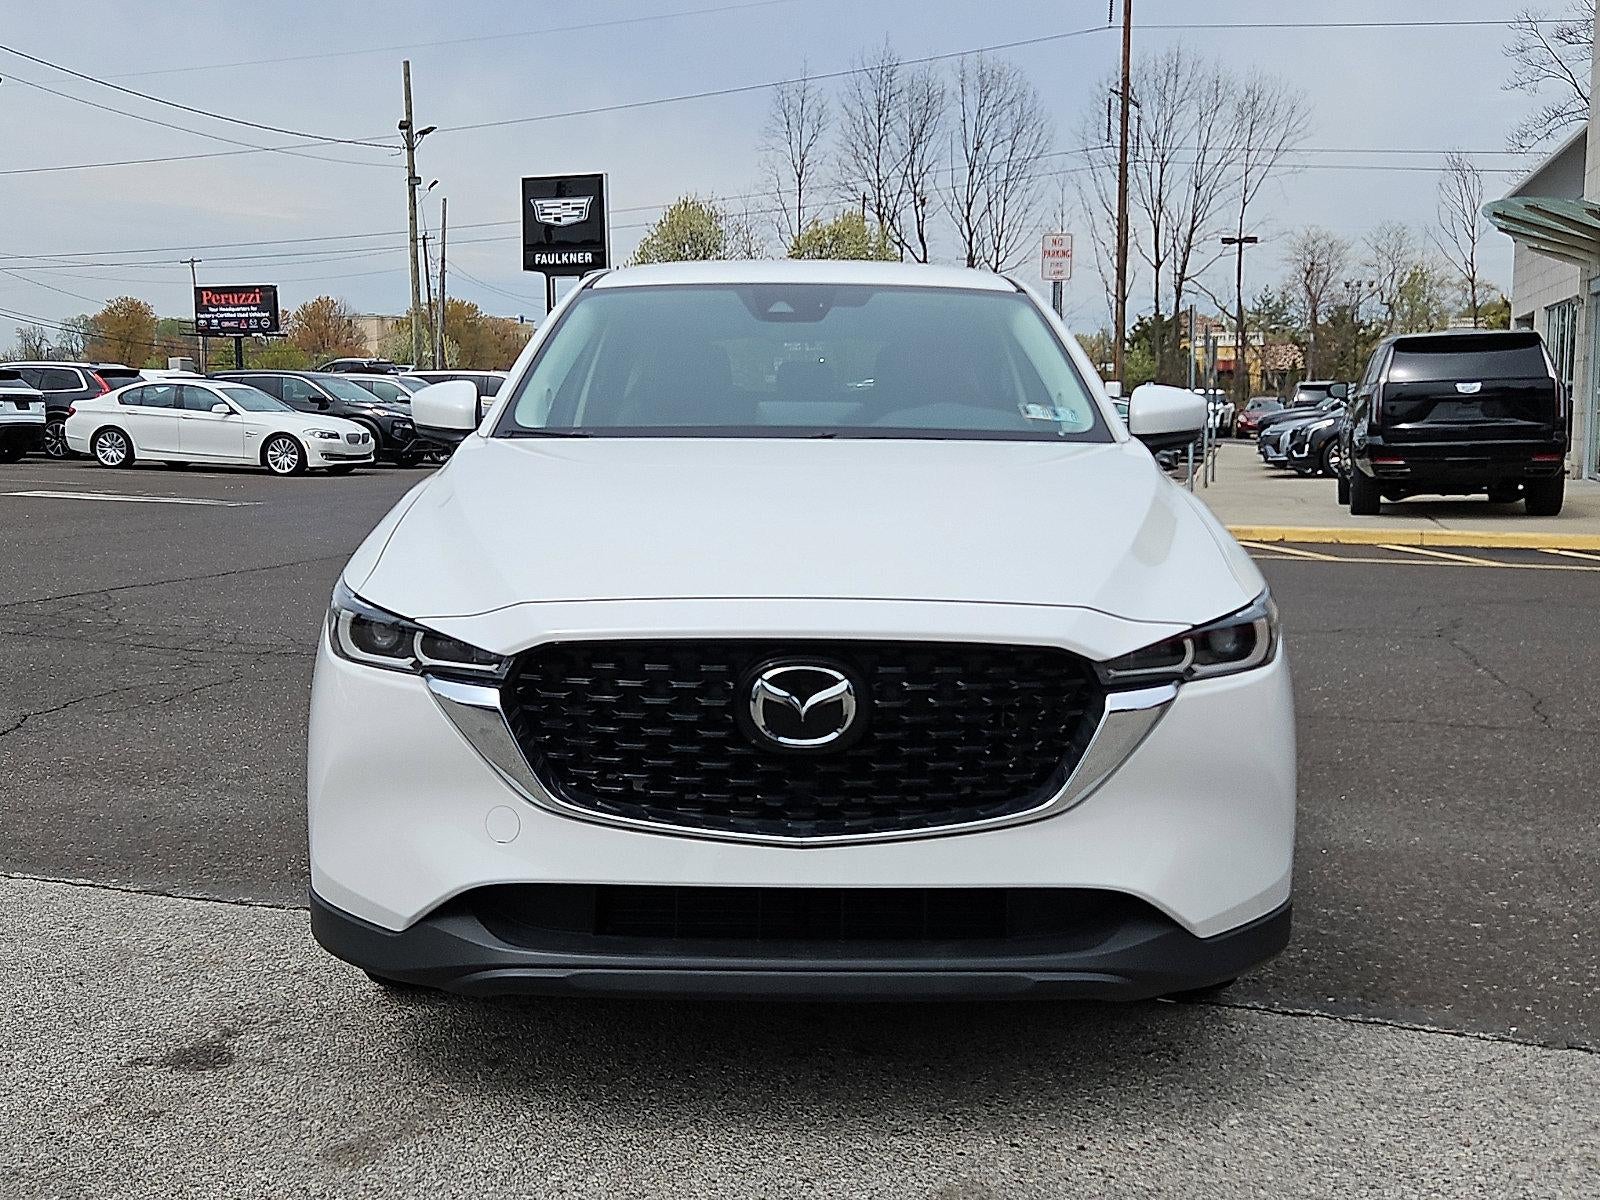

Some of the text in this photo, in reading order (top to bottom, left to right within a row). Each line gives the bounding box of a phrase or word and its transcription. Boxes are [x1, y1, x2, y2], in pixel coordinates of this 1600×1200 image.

[1051, 238, 1063, 247] NO
[534, 251, 593, 265] FAULKNER
[1043, 249, 1070, 259] PARKING
[201, 288, 261, 306] Peruzzi
